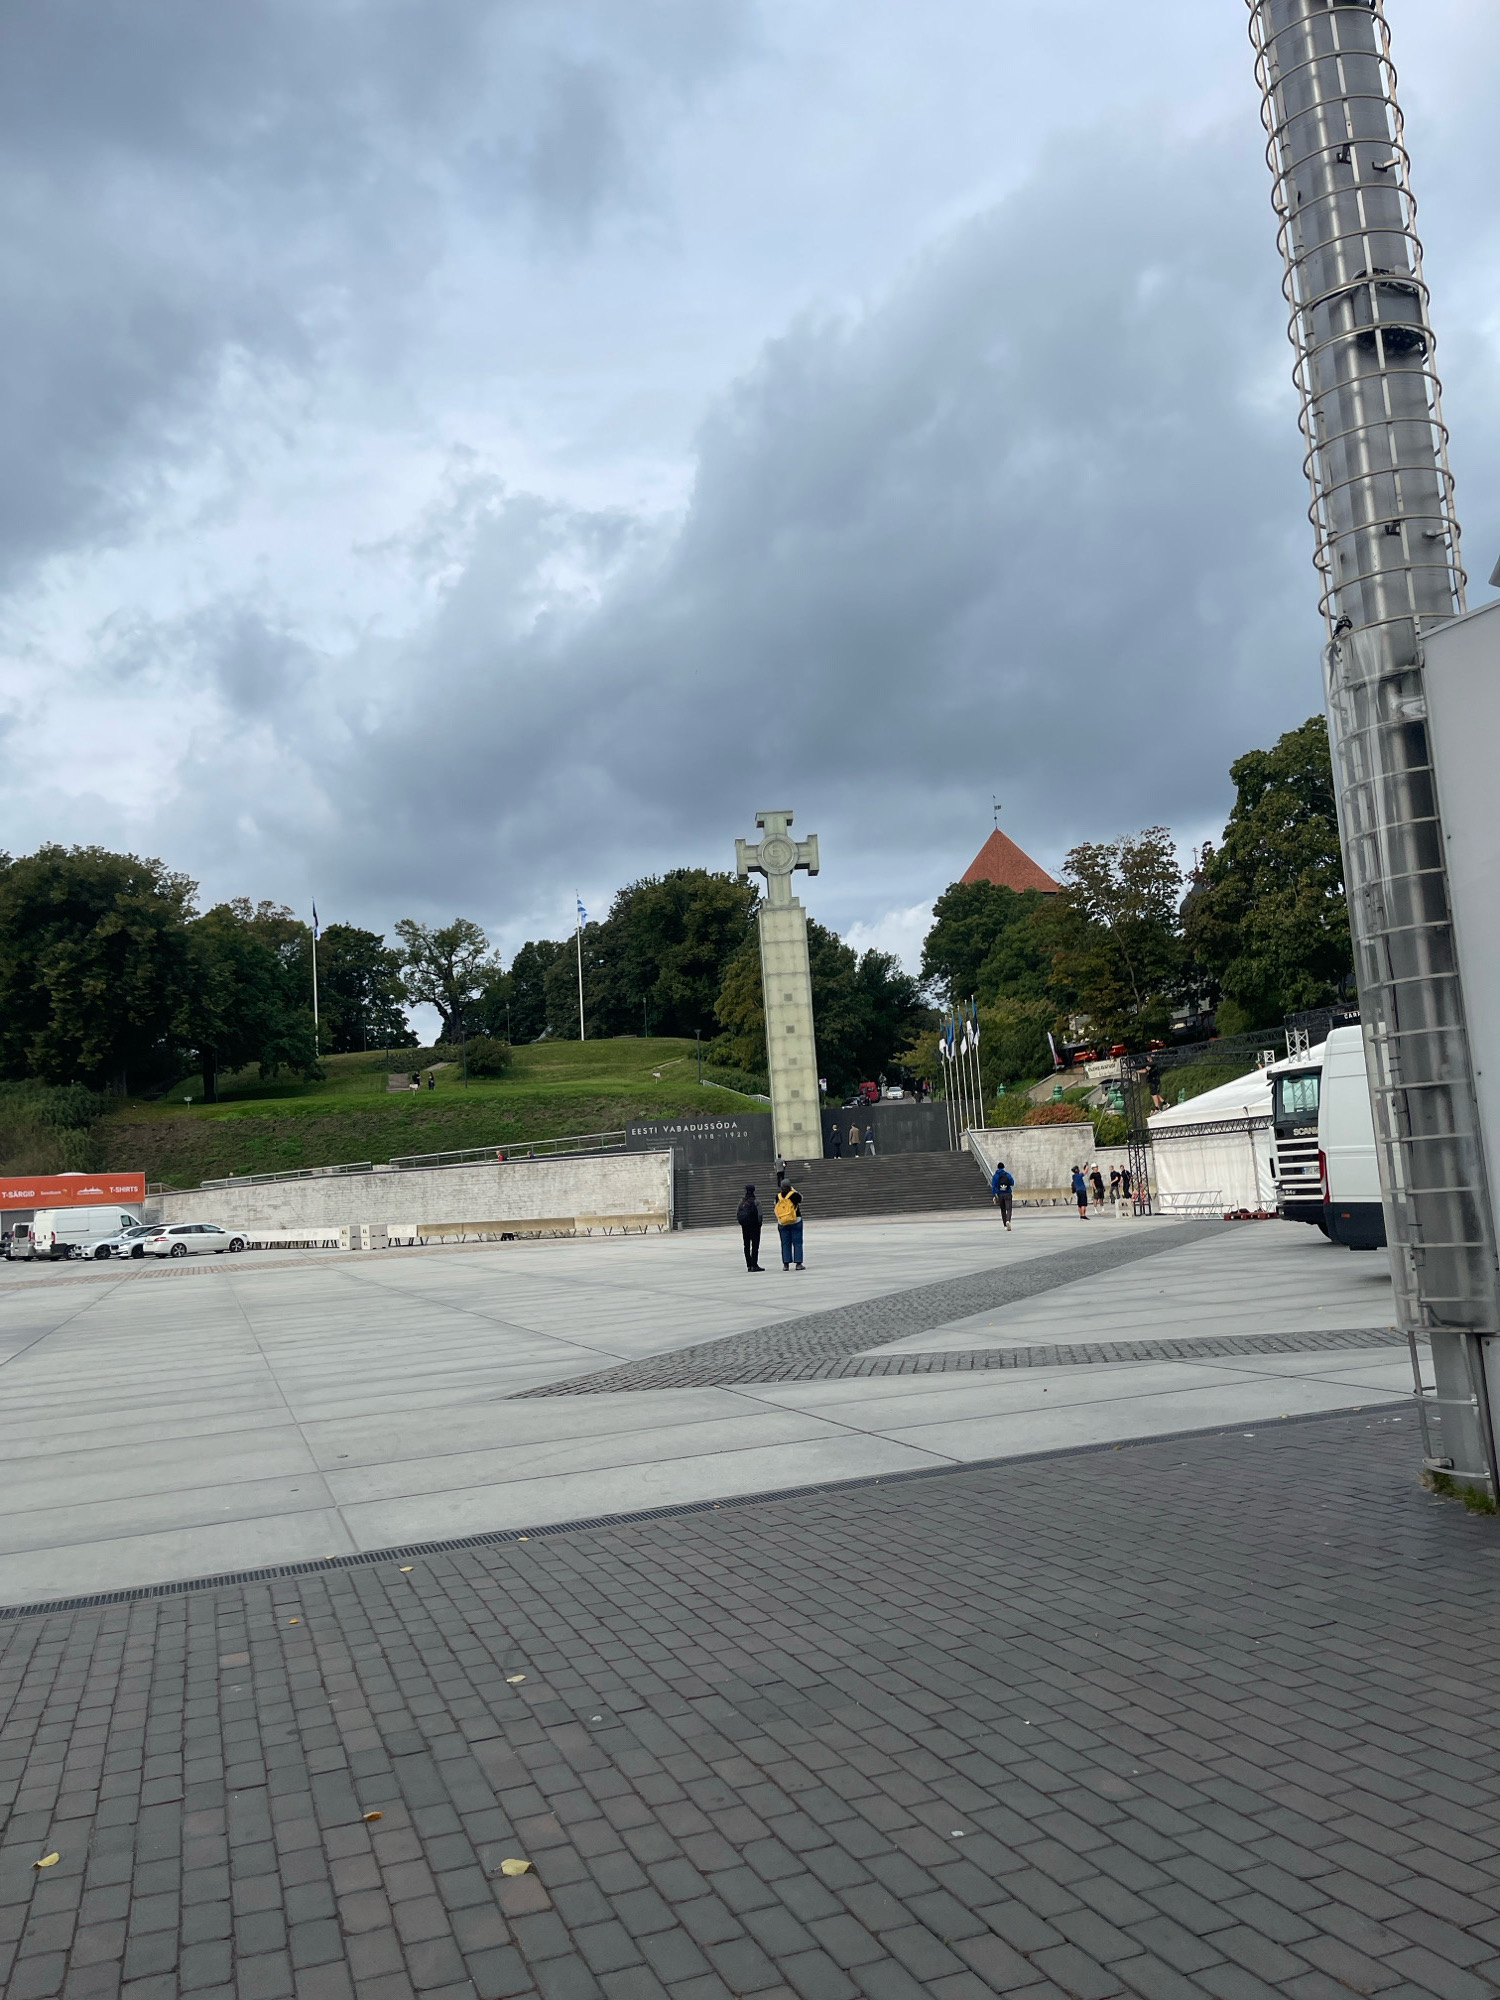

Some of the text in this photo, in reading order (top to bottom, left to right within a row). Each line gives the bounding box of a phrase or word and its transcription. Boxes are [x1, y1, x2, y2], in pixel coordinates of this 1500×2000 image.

[631, 1121, 738, 1136] EESTI VABADUSSÕDA
[1, 1189, 35, 1199] T-SÄRGID
